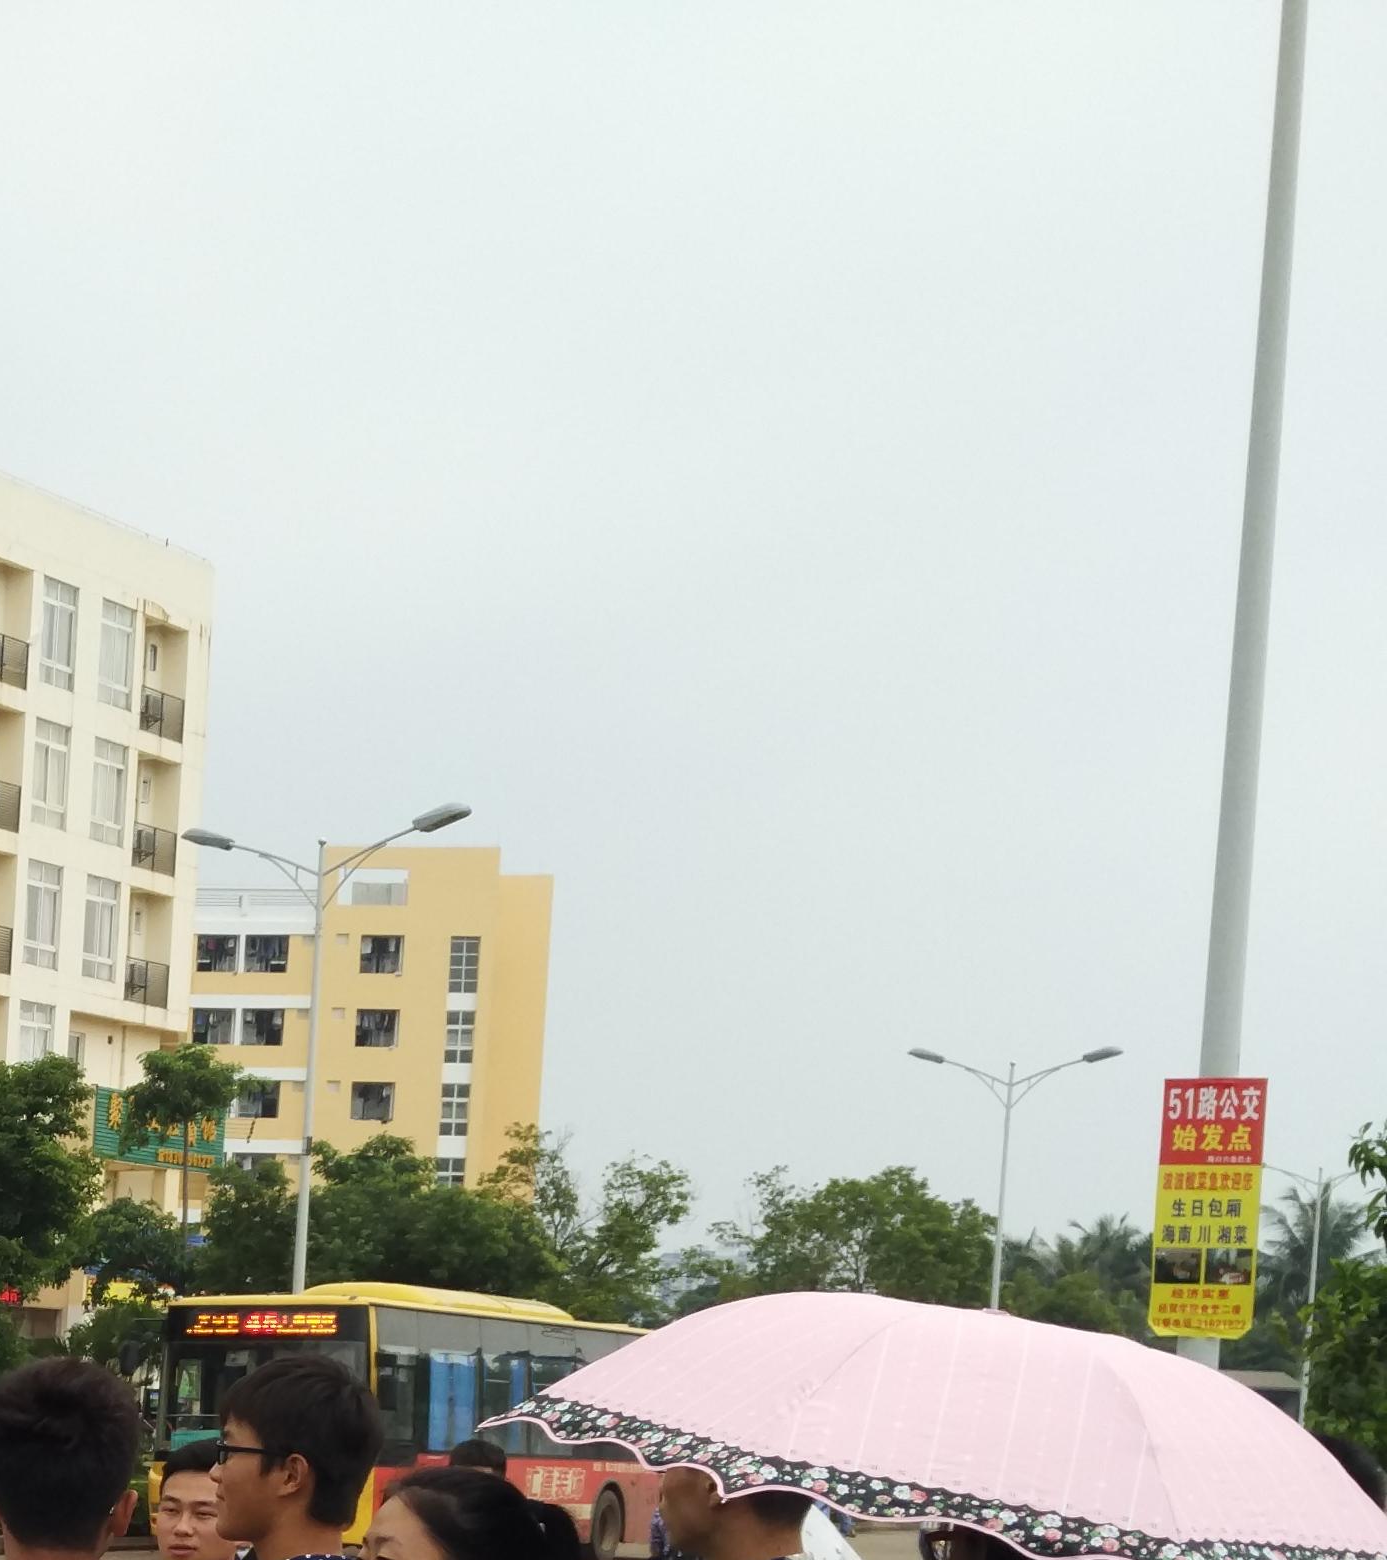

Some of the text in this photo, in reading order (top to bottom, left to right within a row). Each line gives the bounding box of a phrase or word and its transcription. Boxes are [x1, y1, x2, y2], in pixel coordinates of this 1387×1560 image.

[1169, 1086, 1261, 1121] 51路公交
[1171, 1123, 1252, 1152] 始发点
[1171, 1198, 1242, 1218] 生日包厢
